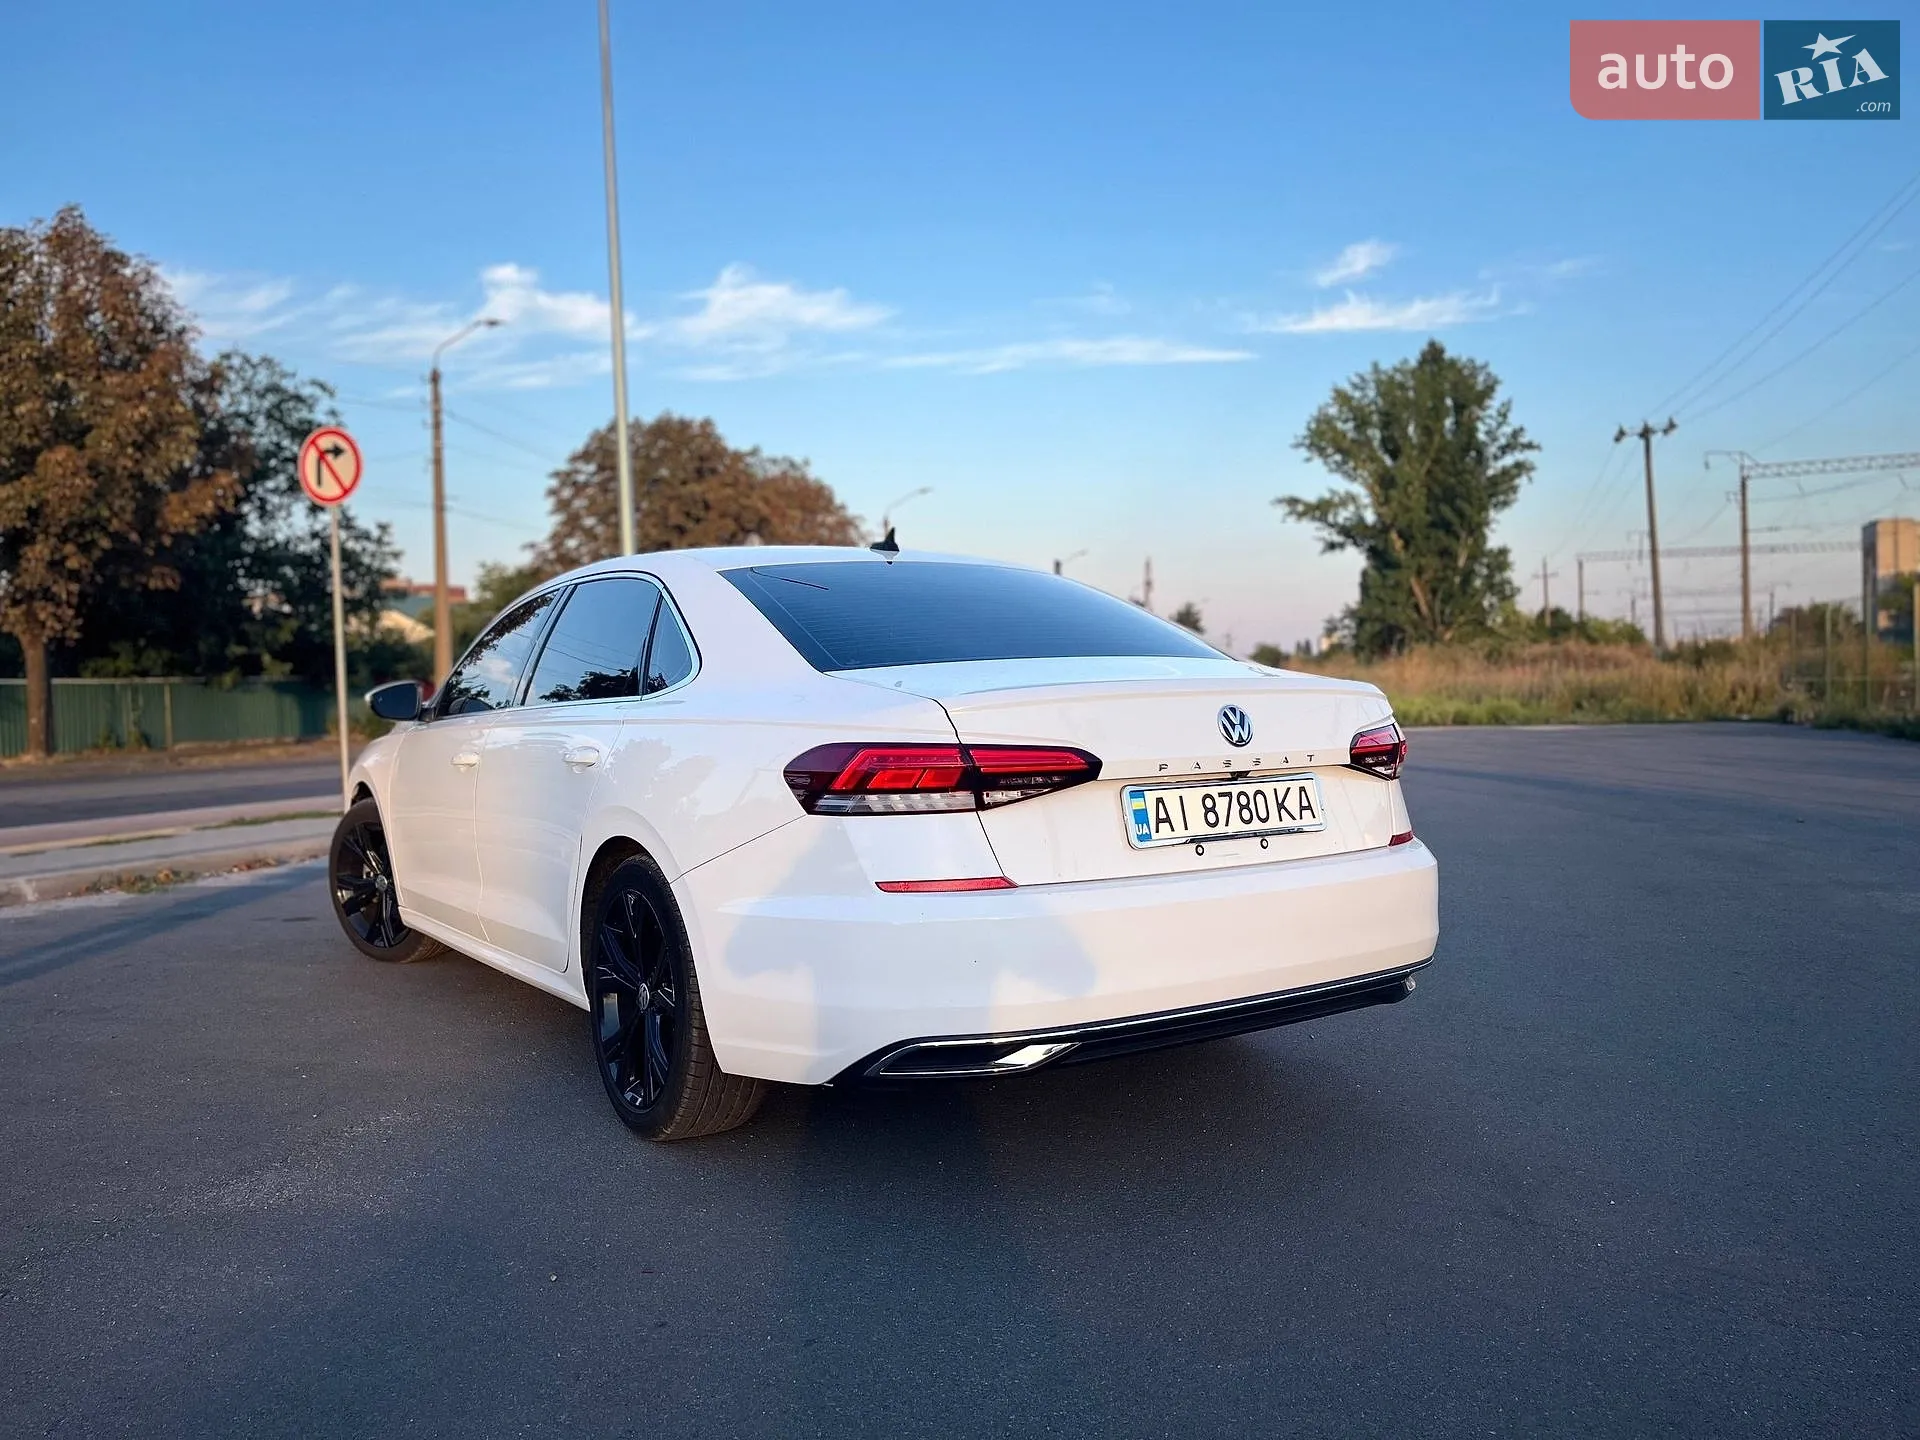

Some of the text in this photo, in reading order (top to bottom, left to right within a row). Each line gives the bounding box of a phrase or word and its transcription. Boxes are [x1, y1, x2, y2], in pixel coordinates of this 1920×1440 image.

[1218, 705, 1252, 746] VW
[1158, 754, 1315, 772] PASSAT
[1155, 786, 1316, 834] AI 8780 KA
[1136, 823, 1150, 835] UA
